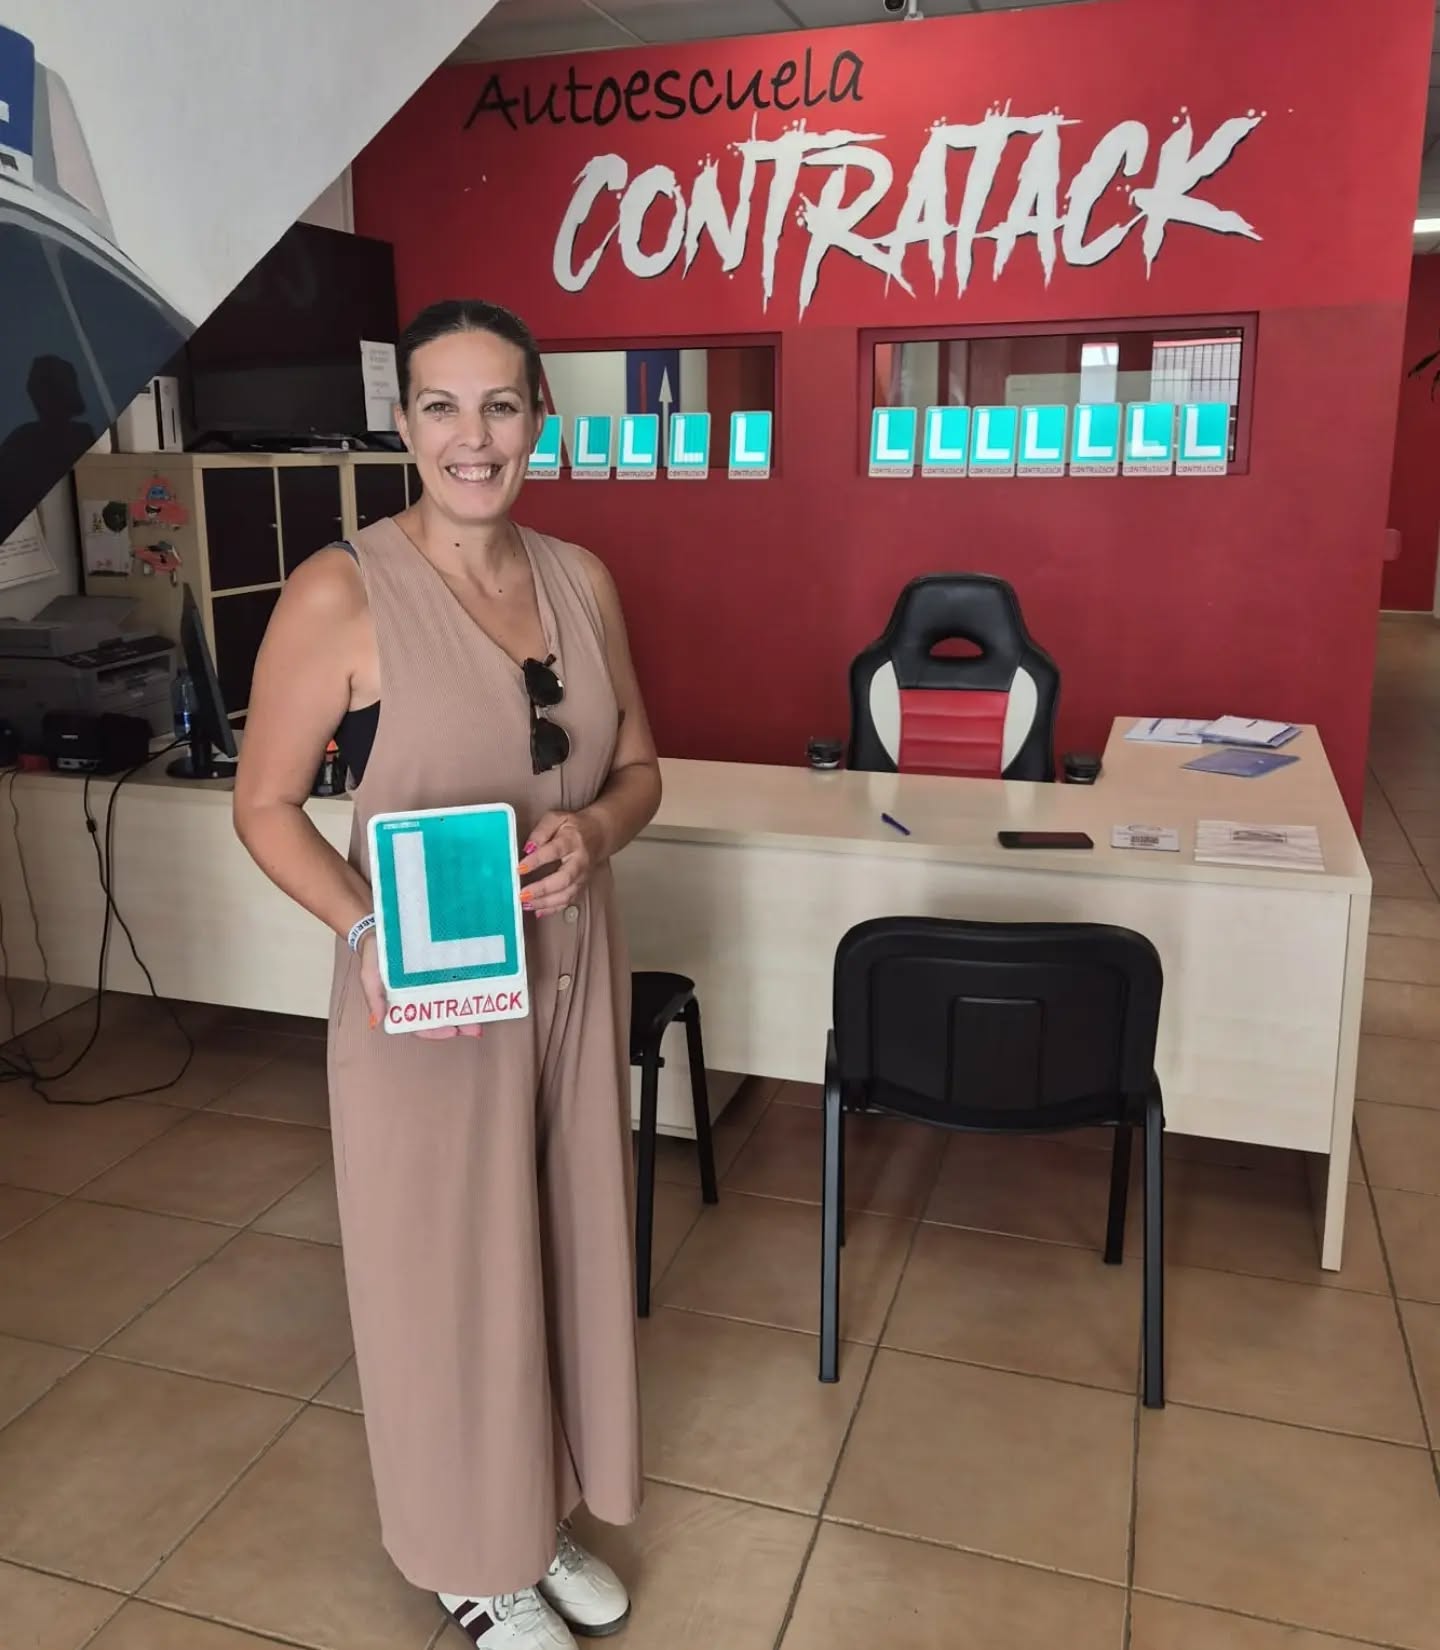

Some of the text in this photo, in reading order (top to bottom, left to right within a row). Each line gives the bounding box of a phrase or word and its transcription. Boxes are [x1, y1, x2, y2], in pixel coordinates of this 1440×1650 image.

[463, 47, 864, 132] Autoescuela
[553, 100, 1264, 321] CONTRATACK
[578, 419, 607, 463] L
[623, 419, 652, 463] L
[674, 418, 704, 463] L
[735, 416, 766, 462] L
[876, 413, 909, 460] L
[929, 413, 963, 460] L
[975, 412, 1010, 460] L
[1024, 411, 1060, 459] L
[1078, 409, 1113, 457] L
[1131, 408, 1167, 457] L
[1184, 407, 1221, 457] L
[392, 831, 506, 974] L
[389, 990, 523, 1025] CONTRATACK
